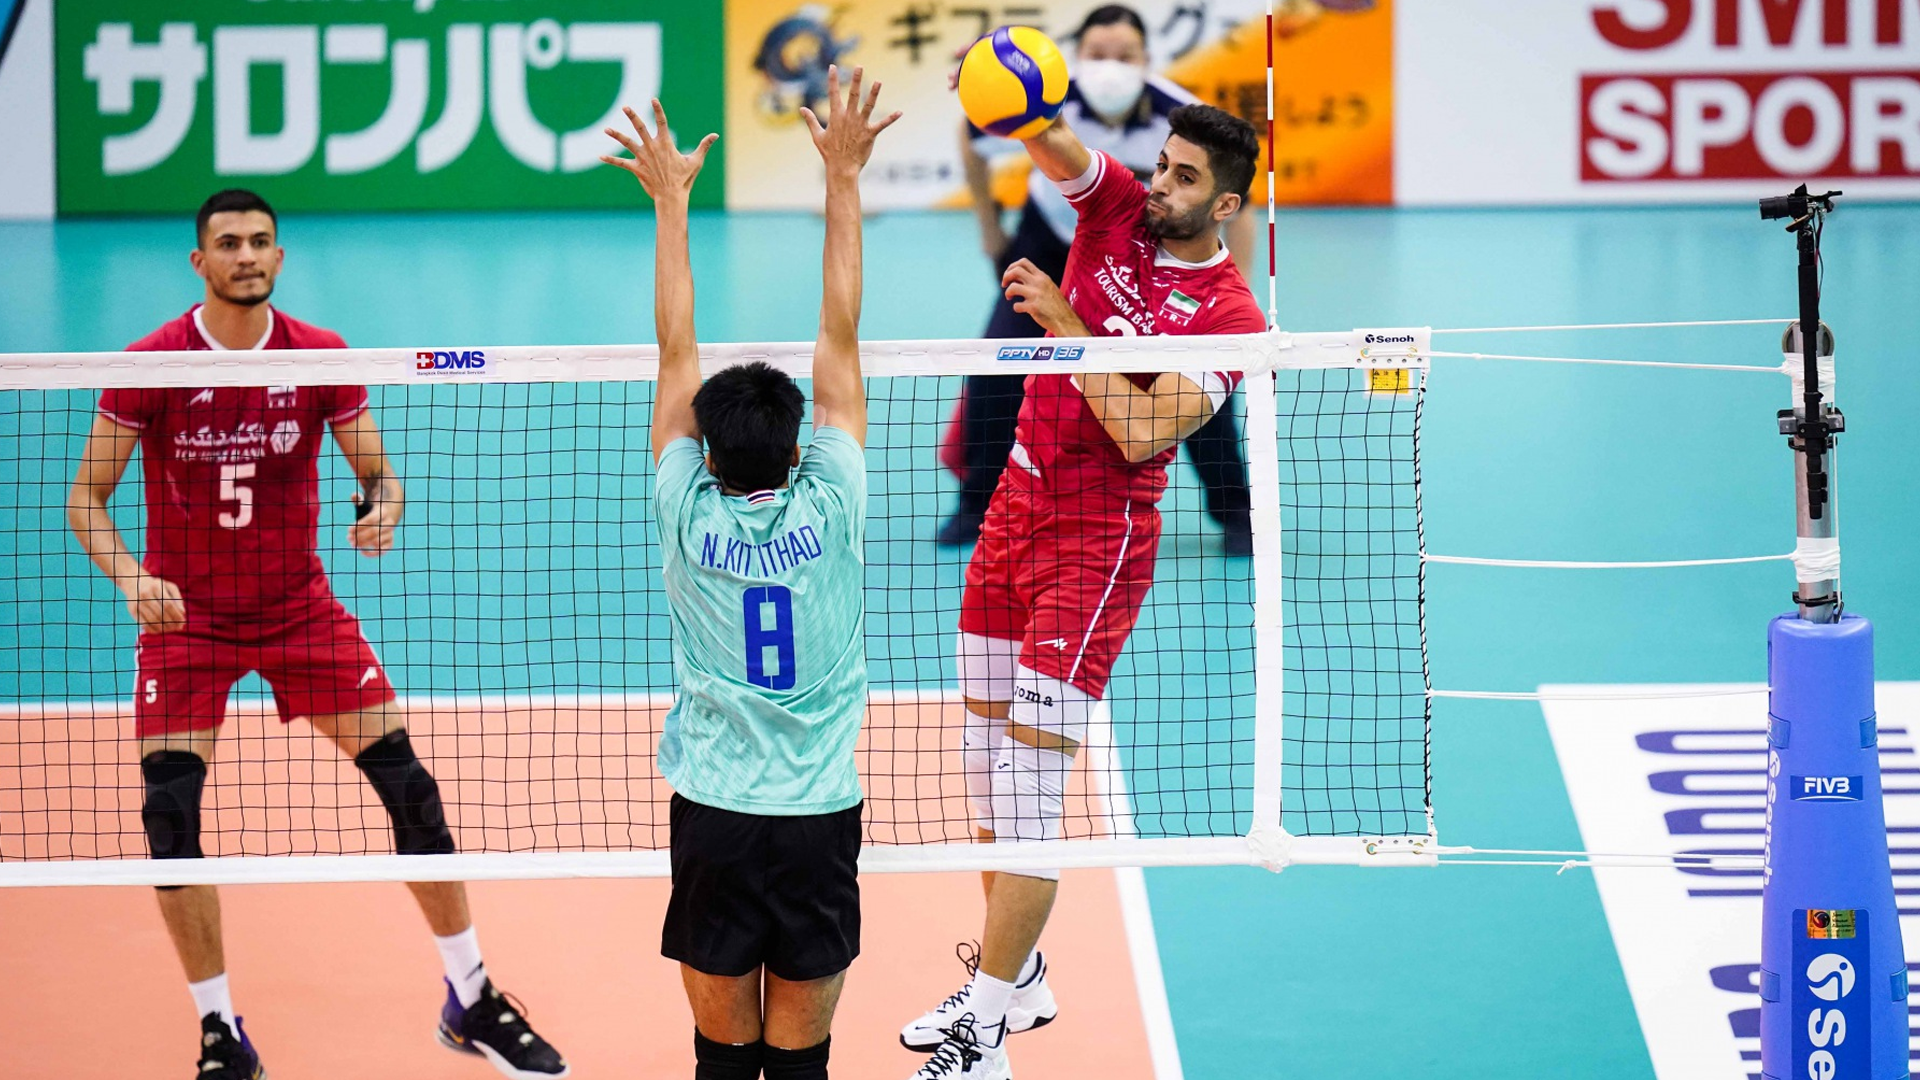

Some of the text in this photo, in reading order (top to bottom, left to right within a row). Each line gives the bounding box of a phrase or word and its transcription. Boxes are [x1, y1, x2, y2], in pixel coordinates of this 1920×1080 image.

[83, 19, 690, 174] サロンパス
[1094, 267, 1134, 315] TOURISM
[998, 347, 1080, 358] PPTV HD 36
[1376, 335, 1414, 343] Senoh
[416, 350, 486, 370] BDMS
[218, 463, 255, 530] 5
[701, 525, 822, 578] N.KITITHAD
[743, 586, 795, 690] 8
[145, 679, 158, 704] 5
[1804, 777, 1850, 794] FIVB
